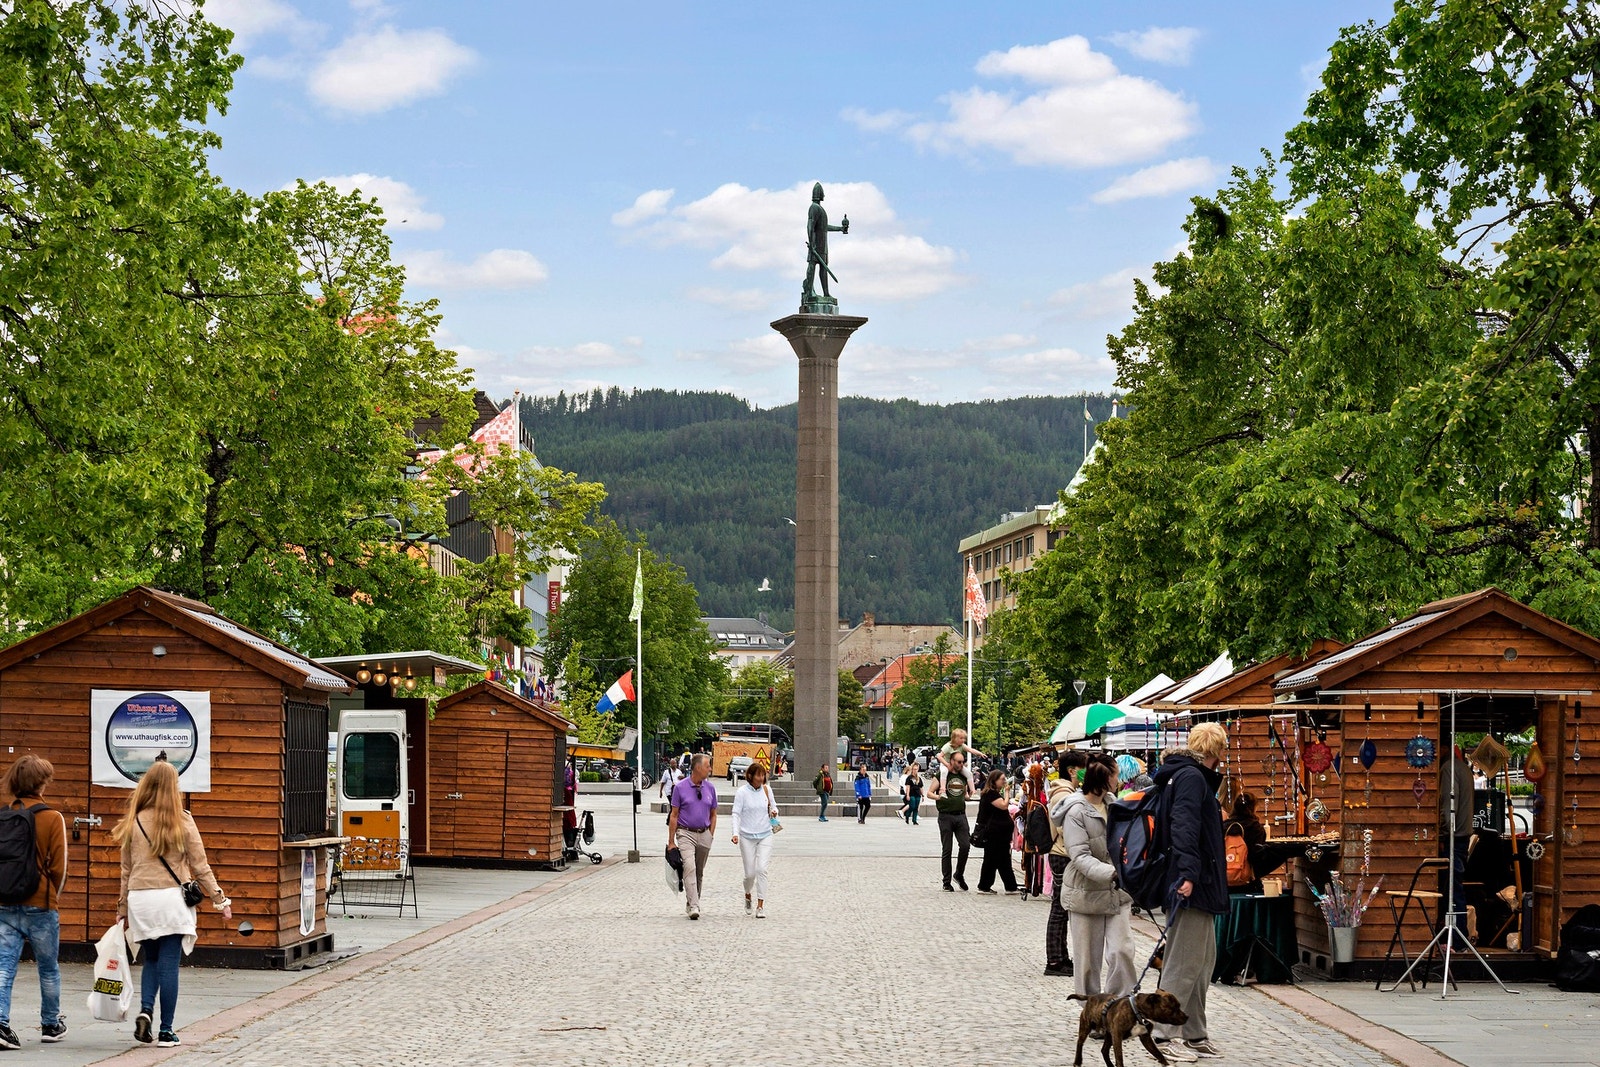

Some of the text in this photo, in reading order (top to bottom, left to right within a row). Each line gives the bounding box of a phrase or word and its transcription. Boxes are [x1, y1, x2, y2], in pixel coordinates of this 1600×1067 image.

[127, 704, 178, 713] Uthaug Fisk
[115, 734, 188, 742] www.uthaugfisk.com
